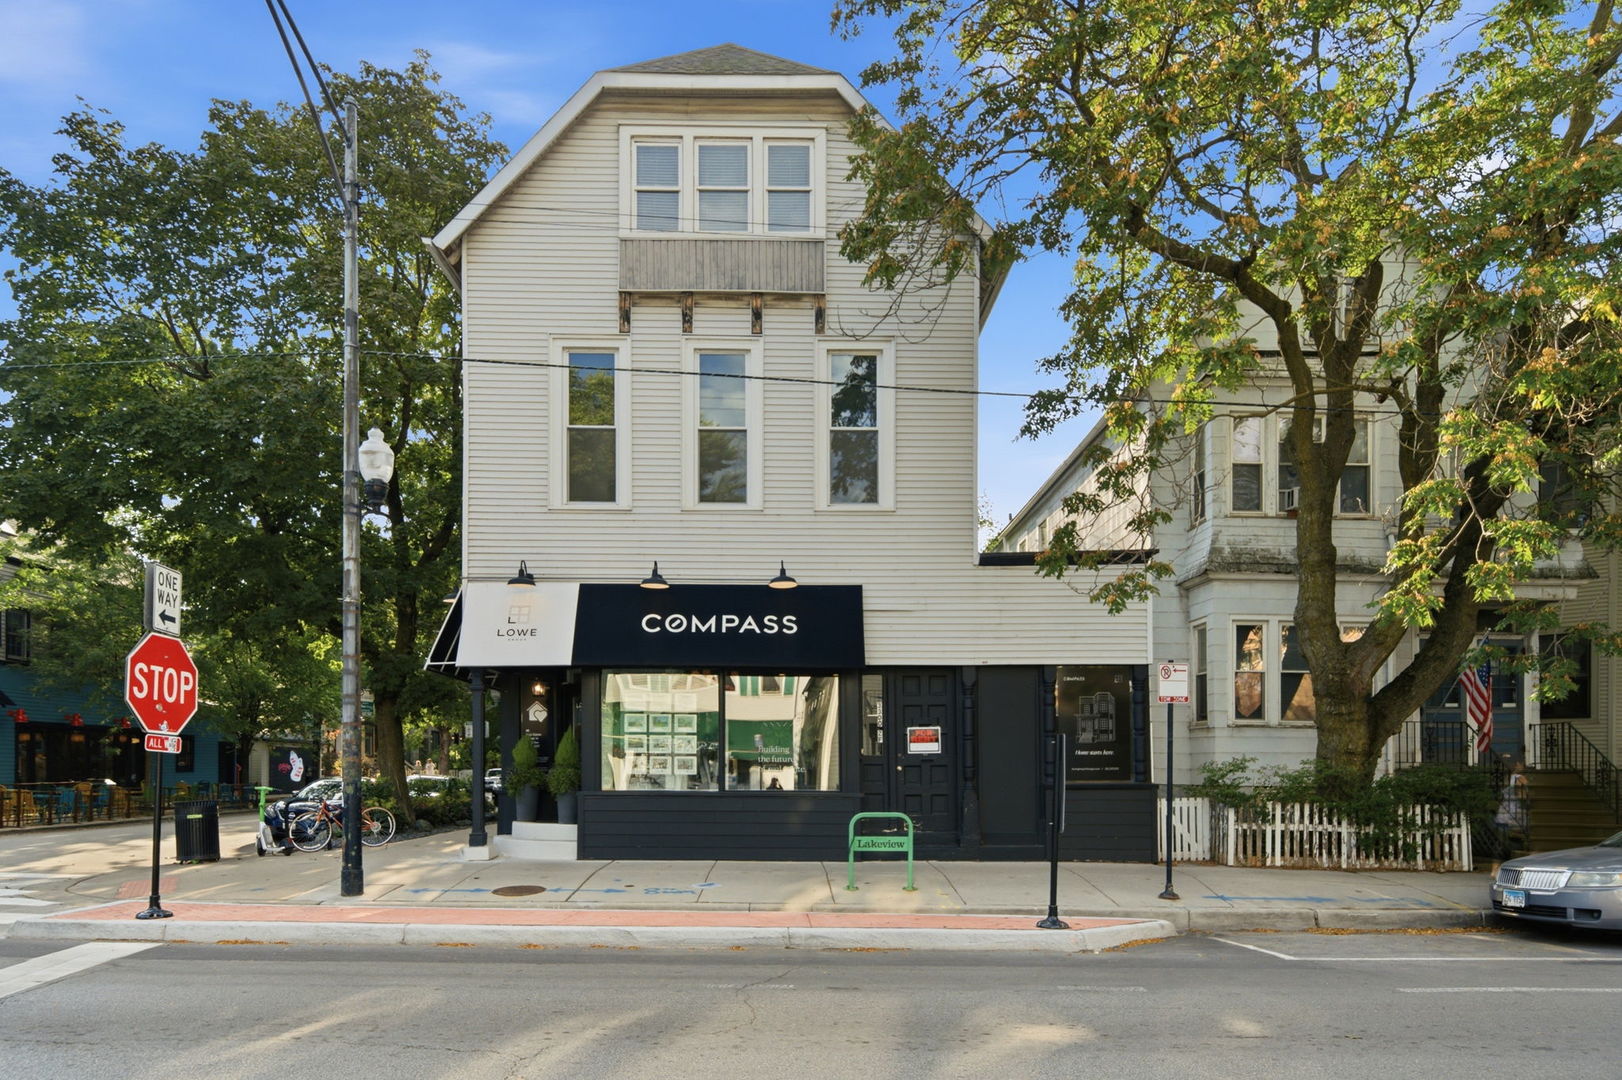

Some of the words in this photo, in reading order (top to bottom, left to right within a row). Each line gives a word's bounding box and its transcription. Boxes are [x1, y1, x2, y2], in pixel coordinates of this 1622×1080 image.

[157, 572, 178, 592] ONE
[157, 588, 178, 609] WAY
[641, 613, 799, 635] COMPASS
[497, 628, 537, 637] LOWE
[132, 662, 194, 705] STOP
[149, 737, 163, 748] ALL
[758, 745, 790, 755] Building
[857, 839, 905, 848] Lakeview
